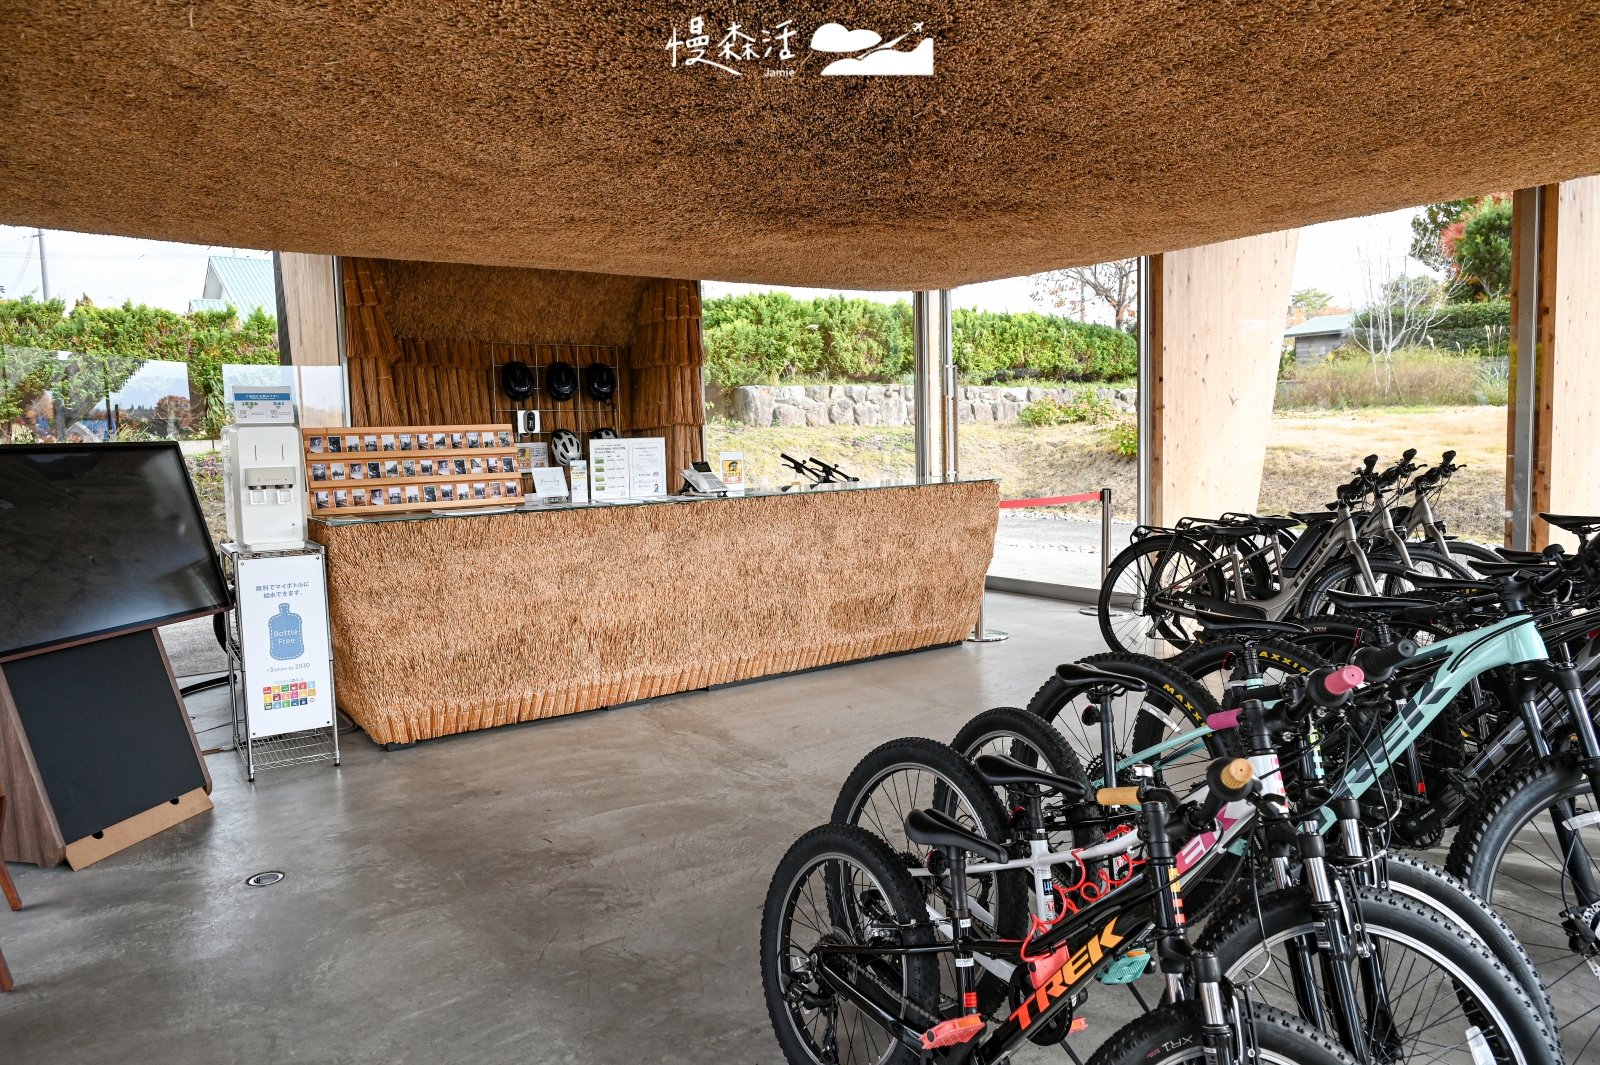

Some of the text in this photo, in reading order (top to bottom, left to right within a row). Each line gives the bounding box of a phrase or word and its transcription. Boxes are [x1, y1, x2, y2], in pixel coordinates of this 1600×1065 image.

[1290, 539, 1329, 589] TREK
[255, 582, 309, 591] 無料でマイボトルに
[273, 629, 298, 638] Bottle
[1259, 651, 1309, 673] AXXIS
[1175, 800, 1239, 876] EK
[1009, 917, 1125, 1031] TREK
[1161, 1034, 1194, 1052] XR1
